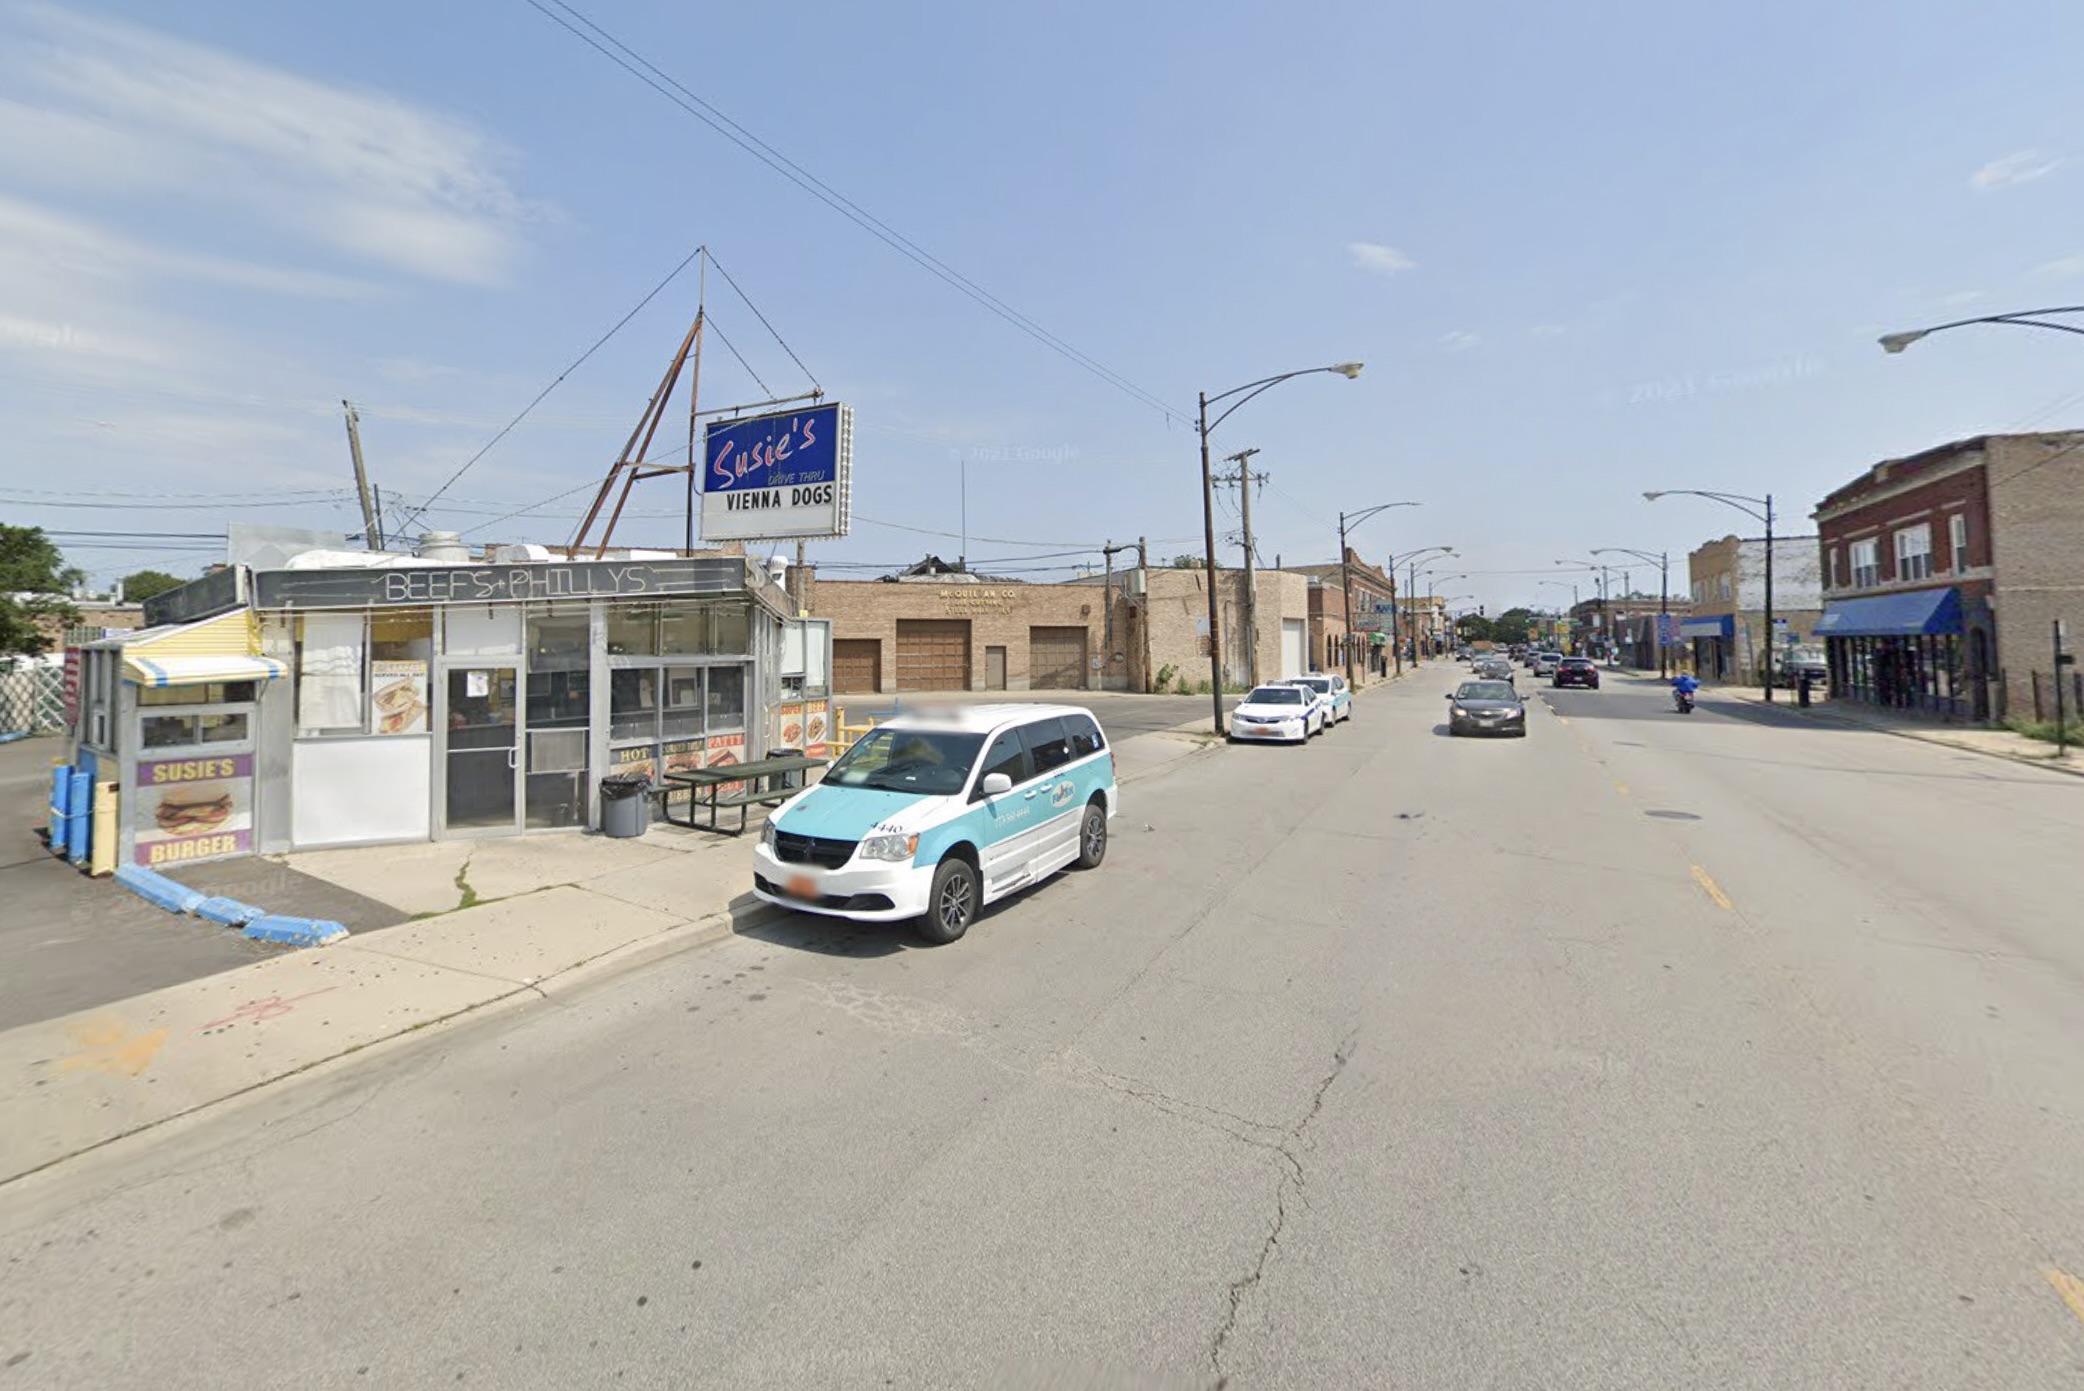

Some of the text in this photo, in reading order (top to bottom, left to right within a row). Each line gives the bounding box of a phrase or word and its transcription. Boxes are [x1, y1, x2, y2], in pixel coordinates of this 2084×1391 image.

[713, 417, 816, 489] Susie's
[767, 470, 826, 486] DRIVE THRU
[727, 485, 833, 511] VIENNA DOGS
[509, 566, 646, 597] PHILLYS
[807, 700, 825, 714] BEEF
[708, 734, 743, 749] PATTY
[620, 747, 650, 763] HOT
[153, 758, 235, 783] SUSIE'S
[150, 834, 237, 864] BURGER
